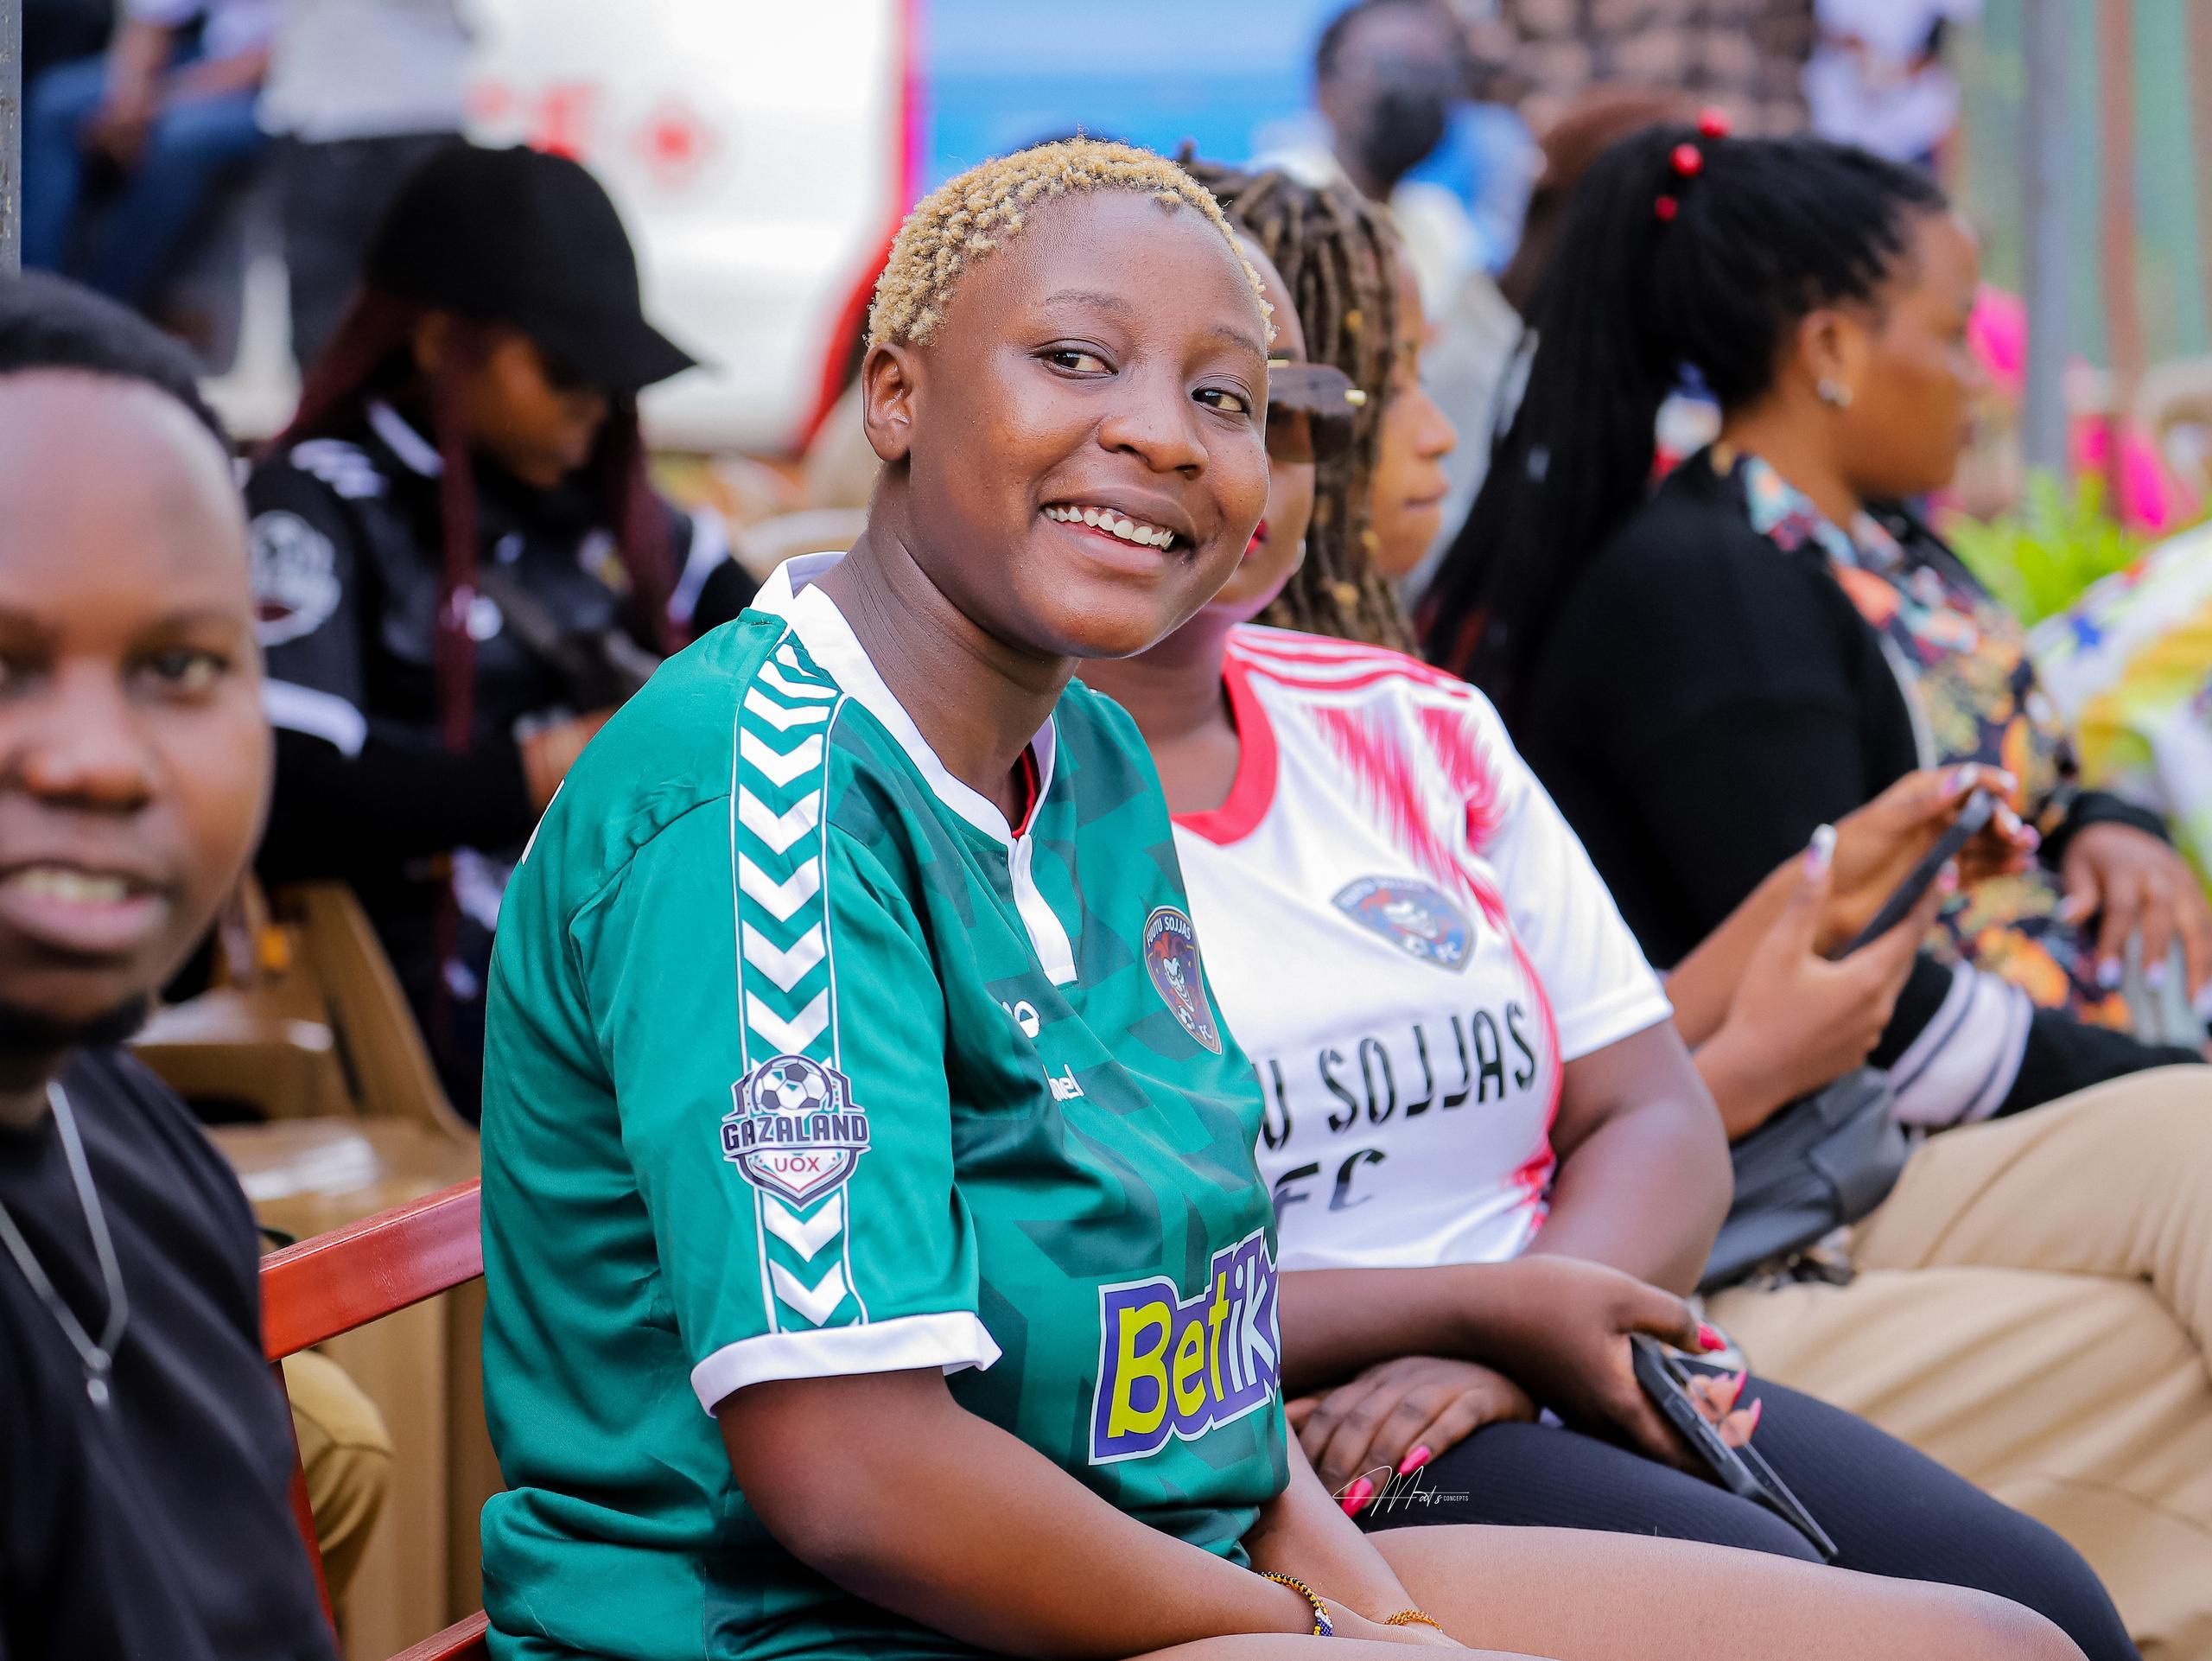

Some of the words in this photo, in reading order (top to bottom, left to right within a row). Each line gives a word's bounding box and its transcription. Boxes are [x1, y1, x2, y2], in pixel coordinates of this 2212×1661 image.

[1164, 916, 1192, 940] SOJJAS
[1319, 1002, 1535, 1134] SOJJAS
[723, 1115, 868, 1150] GAZALAND
[774, 1156, 821, 1174] UOX
[1272, 1148, 1387, 1232] FC
[1107, 1254, 1281, 1439] Betik
